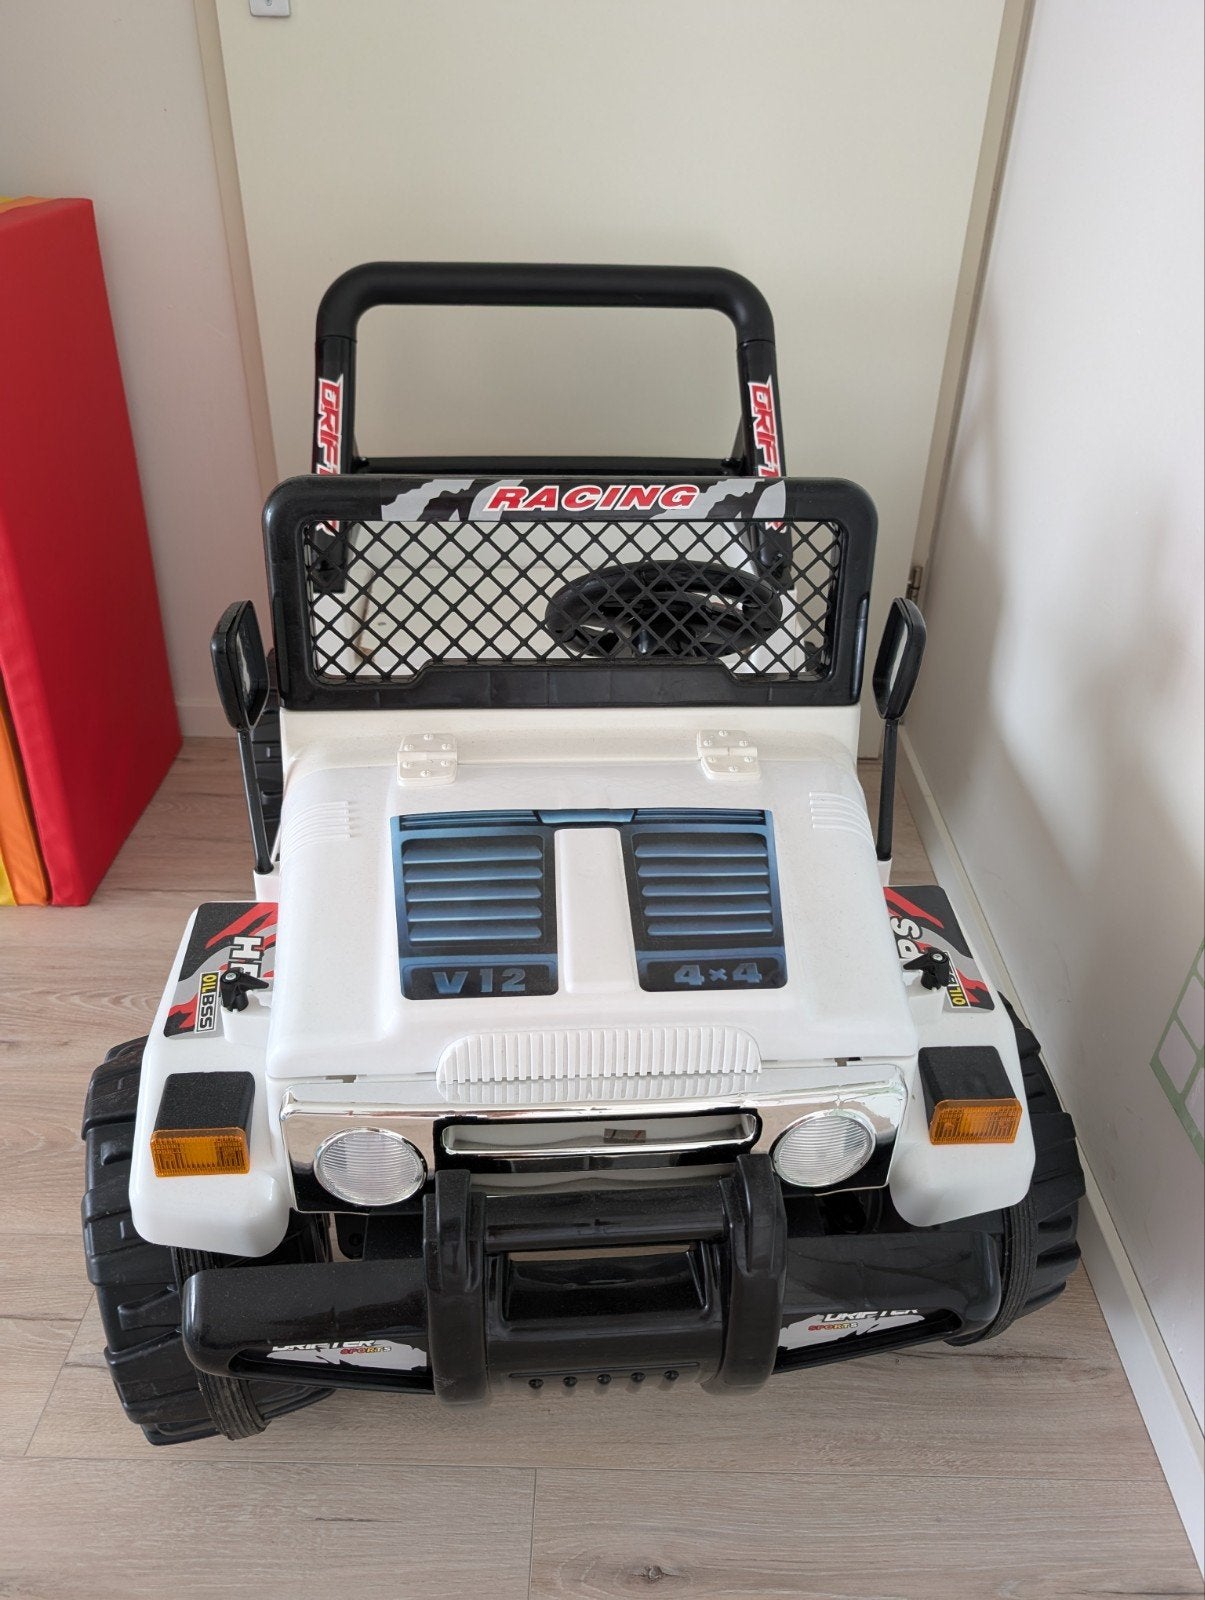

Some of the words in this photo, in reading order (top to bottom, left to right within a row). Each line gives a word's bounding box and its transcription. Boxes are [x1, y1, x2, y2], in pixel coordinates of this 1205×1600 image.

[482, 484, 699, 511] RACING
[807, 1321, 859, 1332] SPORTS
[340, 1345, 392, 1355] SPORTS
